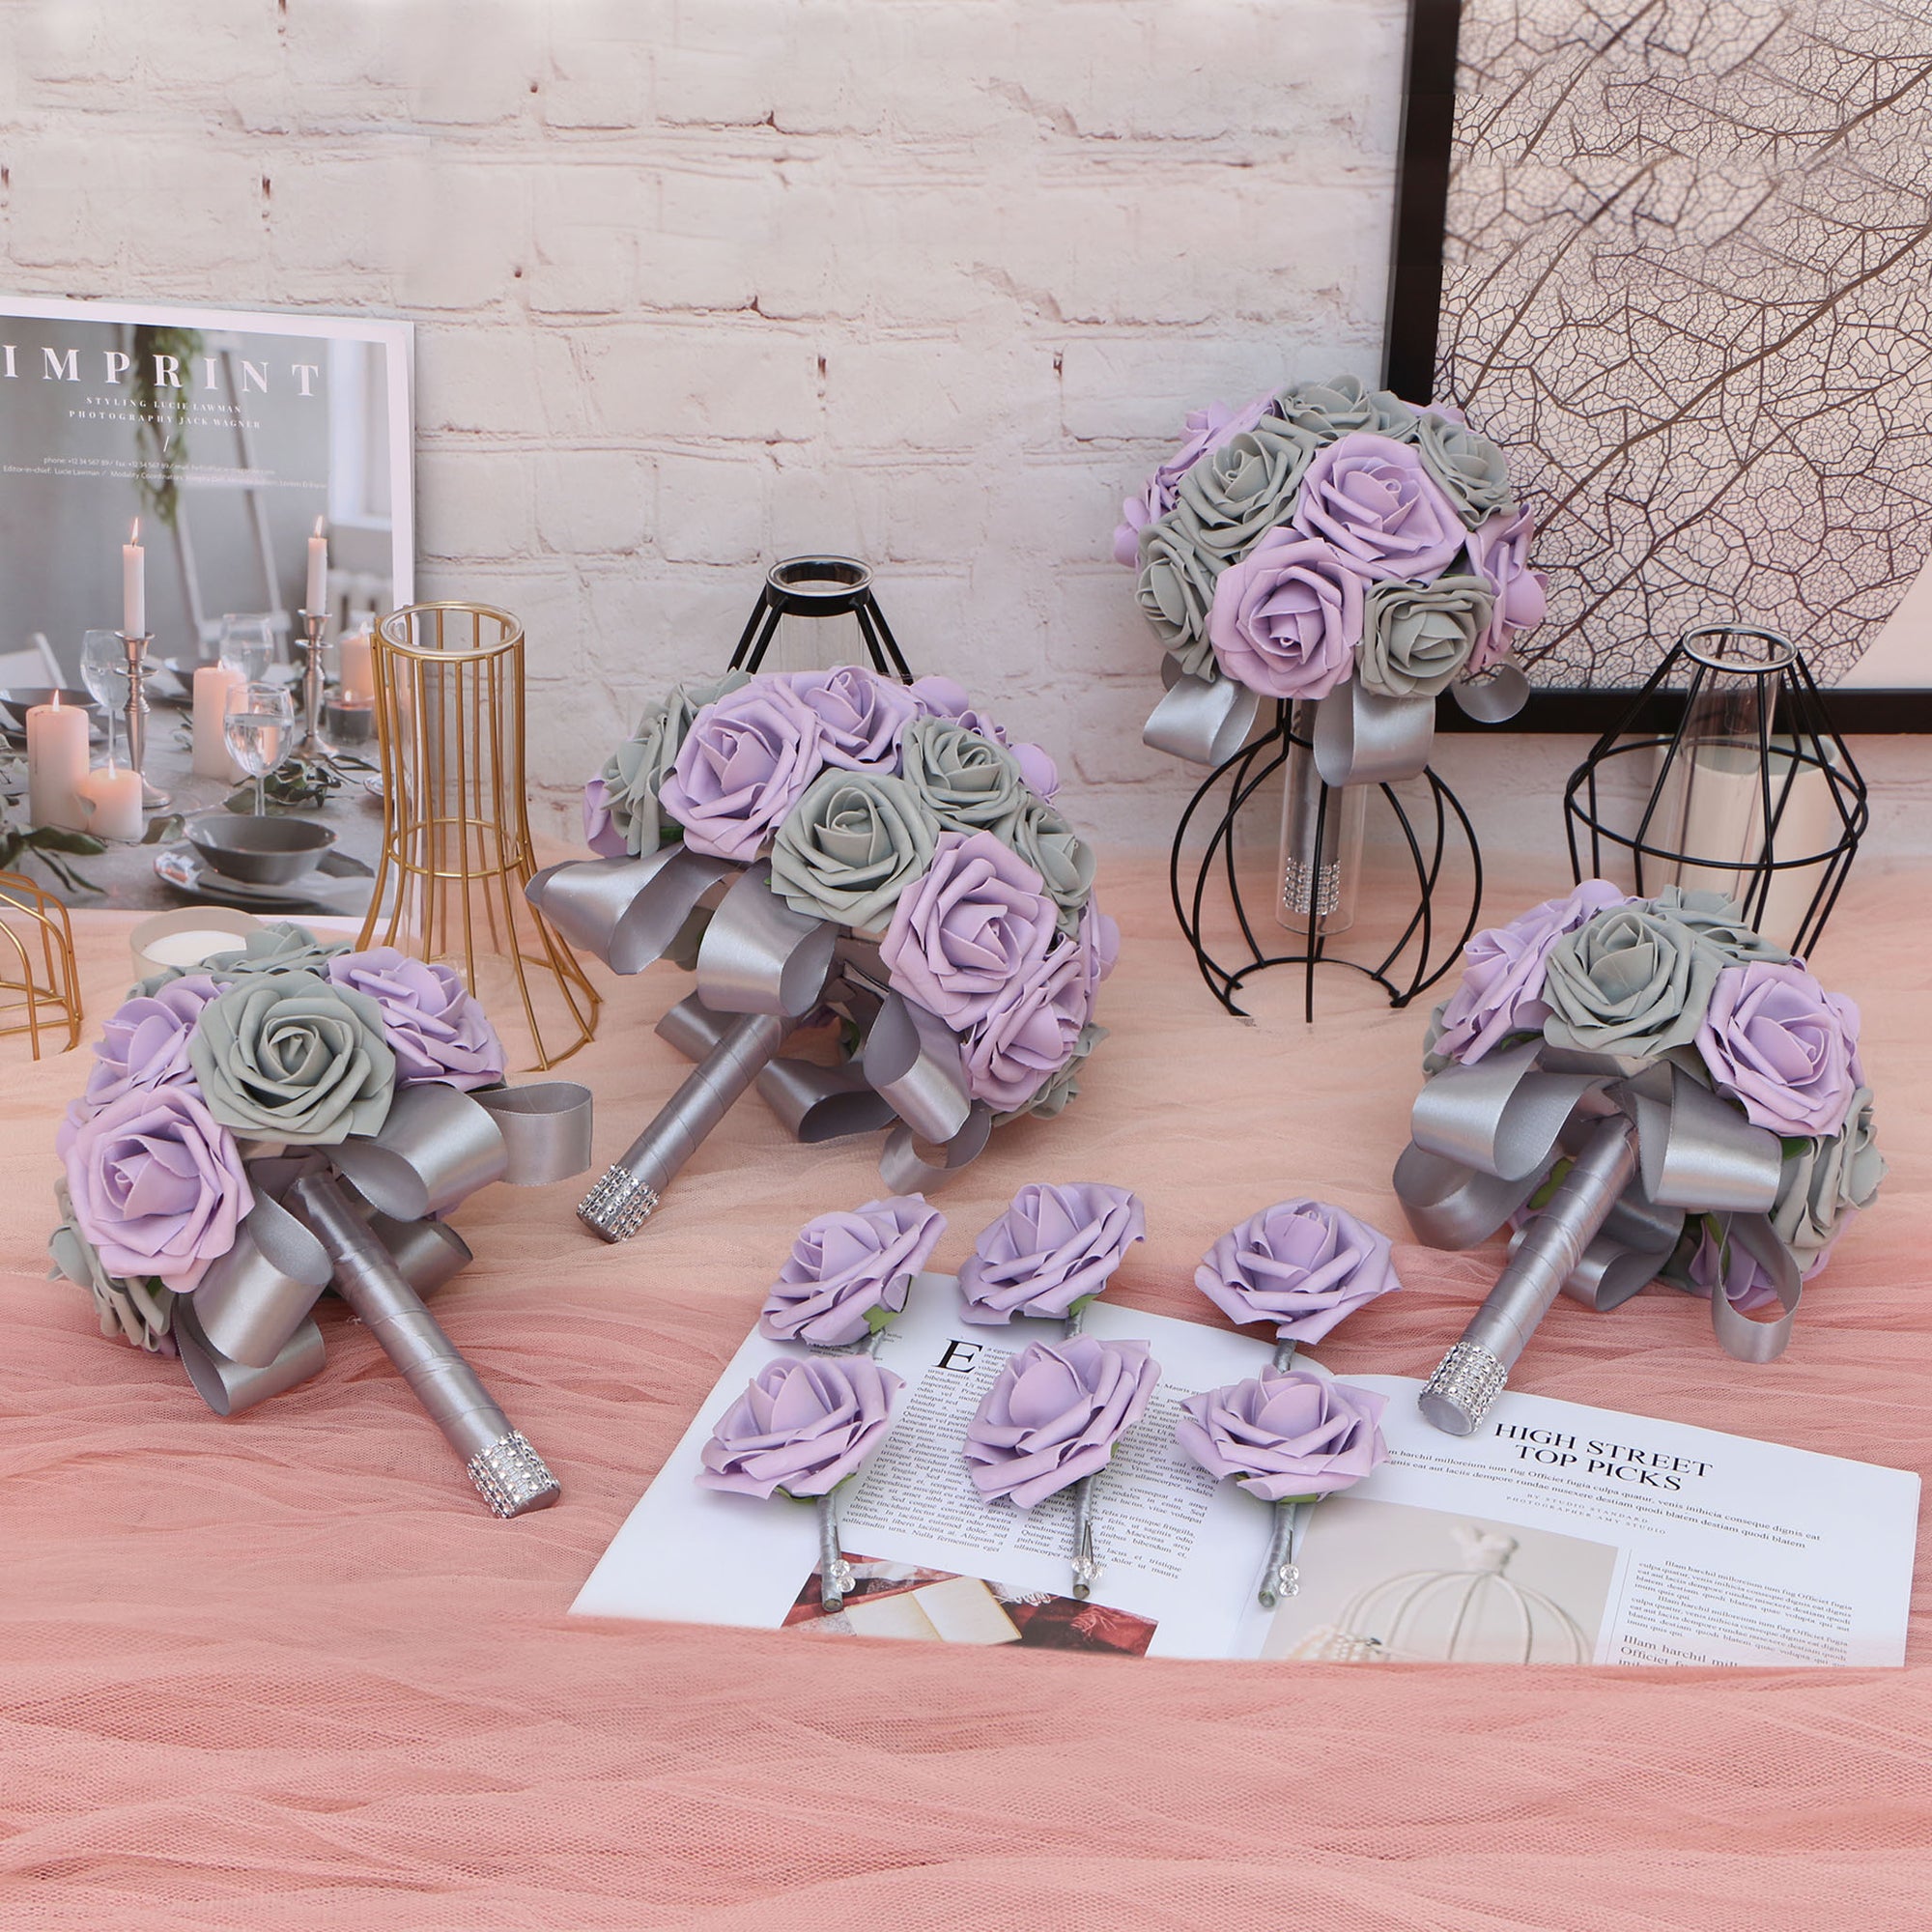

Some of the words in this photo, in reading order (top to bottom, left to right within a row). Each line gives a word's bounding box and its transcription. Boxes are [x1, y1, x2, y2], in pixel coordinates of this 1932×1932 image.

[2, 344, 320, 397] IMPRINT
[69, 411, 173, 423] PHOTOGRAPHY
[179, 416, 208, 426] JACK
[213, 419, 261, 429] WAGNER
[86, 397, 147, 408] STYLING
[154, 400, 188, 411] LUCIE
[193, 404, 242, 413] LAWMAN
[929, 1338, 982, 1374] E
[1494, 1423, 1577, 1450] HIGH
[1586, 1439, 1714, 1477] STREET
[1515, 1444, 1578, 1468] TOP
[1587, 1459, 1683, 1492] PICKS
[1400, 1450, 1433, 1461] harchil
[1510, 1467, 1525, 1477] fug
[1528, 1470, 1564, 1483] Officiet
[1567, 1478, 1592, 1489] fugia
[1593, 1486, 1620, 1495] culpa
[1658, 1500, 1684, 1509] venis
[1724, 1516, 1771, 1530] conseque
[1772, 1525, 1804, 1537] dignis
[1472, 1471, 1514, 1483] dempore
[1516, 1480, 1549, 1490] rundae
[1595, 1494, 1634, 1508] destiam
[1634, 1505, 1663, 1515] quodi
[1665, 1510, 1699, 1522] blatem
[1700, 1519, 1739, 1533] destiam
[1740, 1530, 1770, 1540] quodi
[1771, 1535, 1806, 1548] blatem
[1546, 1497, 1585, 1510] STUDIO
[1589, 1507, 1649, 1523] STANDARD
[1506, 1495, 1592, 1518] PHOTOGRAPHER
[1597, 1515, 1621, 1523] AMY
[1626, 1521, 1666, 1534] STUDIO
[1620, 1645, 1669, 1665] Officiet
[1623, 1634, 1658, 1650] Illam
[1662, 1644, 1707, 1662] harchil
